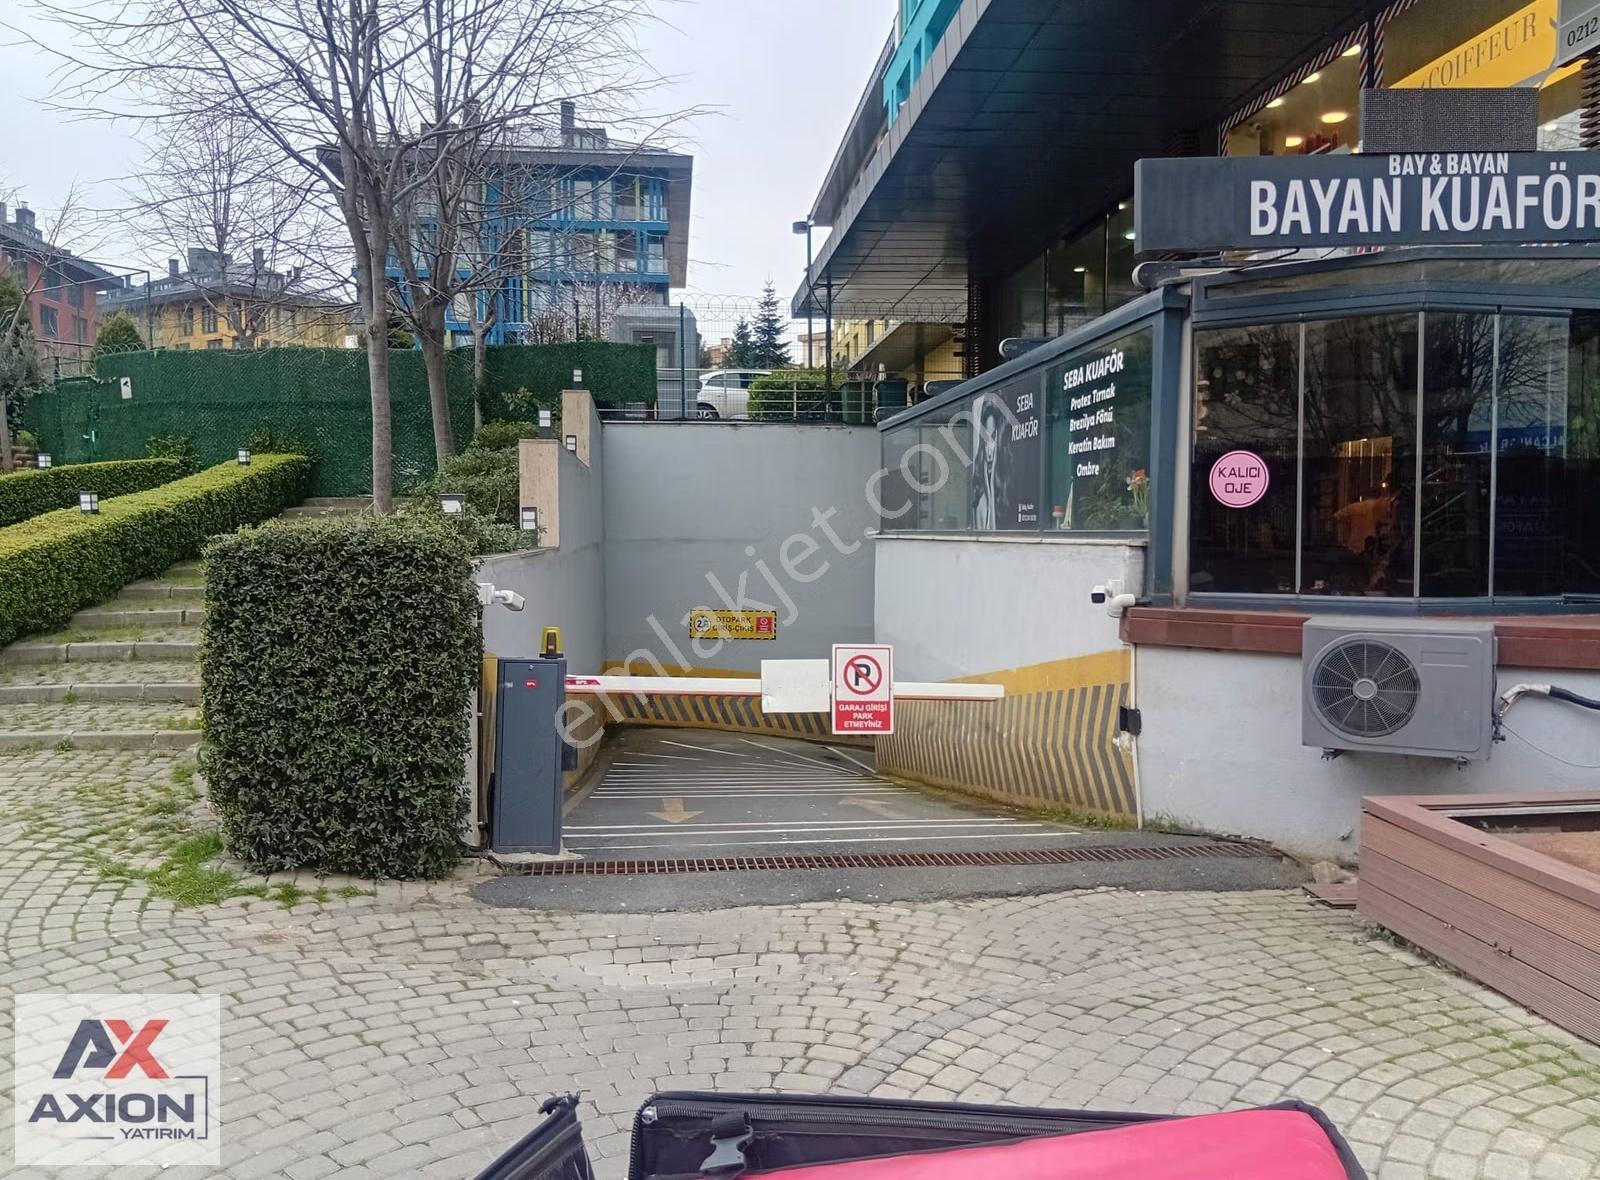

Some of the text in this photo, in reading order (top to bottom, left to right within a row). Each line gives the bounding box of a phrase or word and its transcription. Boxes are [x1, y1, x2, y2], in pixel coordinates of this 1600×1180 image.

[1567, 16, 1599, 47] 0212
[1429, 12, 1537, 88] COIFFEUR
[1446, 153, 1509, 175] BAYAN
[1250, 161, 1600, 236] BAYAN KUAFÖR
[1063, 348, 1124, 391] SEBA KUAFÖR
[1016, 392, 1034, 413] SEBA
[1070, 382, 1116, 412] Protez Tırnak
[1011, 415, 1039, 441] KUAFÖR
[1069, 406, 1114, 432] Brezilya Fönü
[1068, 435, 1116, 455] Keratin Bakım
[1076, 461, 1100, 477] Ombre
[1218, 467, 1261, 478] KALICI
[1225, 483, 1252, 494] OJE
[838, 703, 888, 713] GARAJ GİRİŞİ
[852, 712, 873, 720] PARK
[844, 720, 883, 728] ETMEYİNİZ
